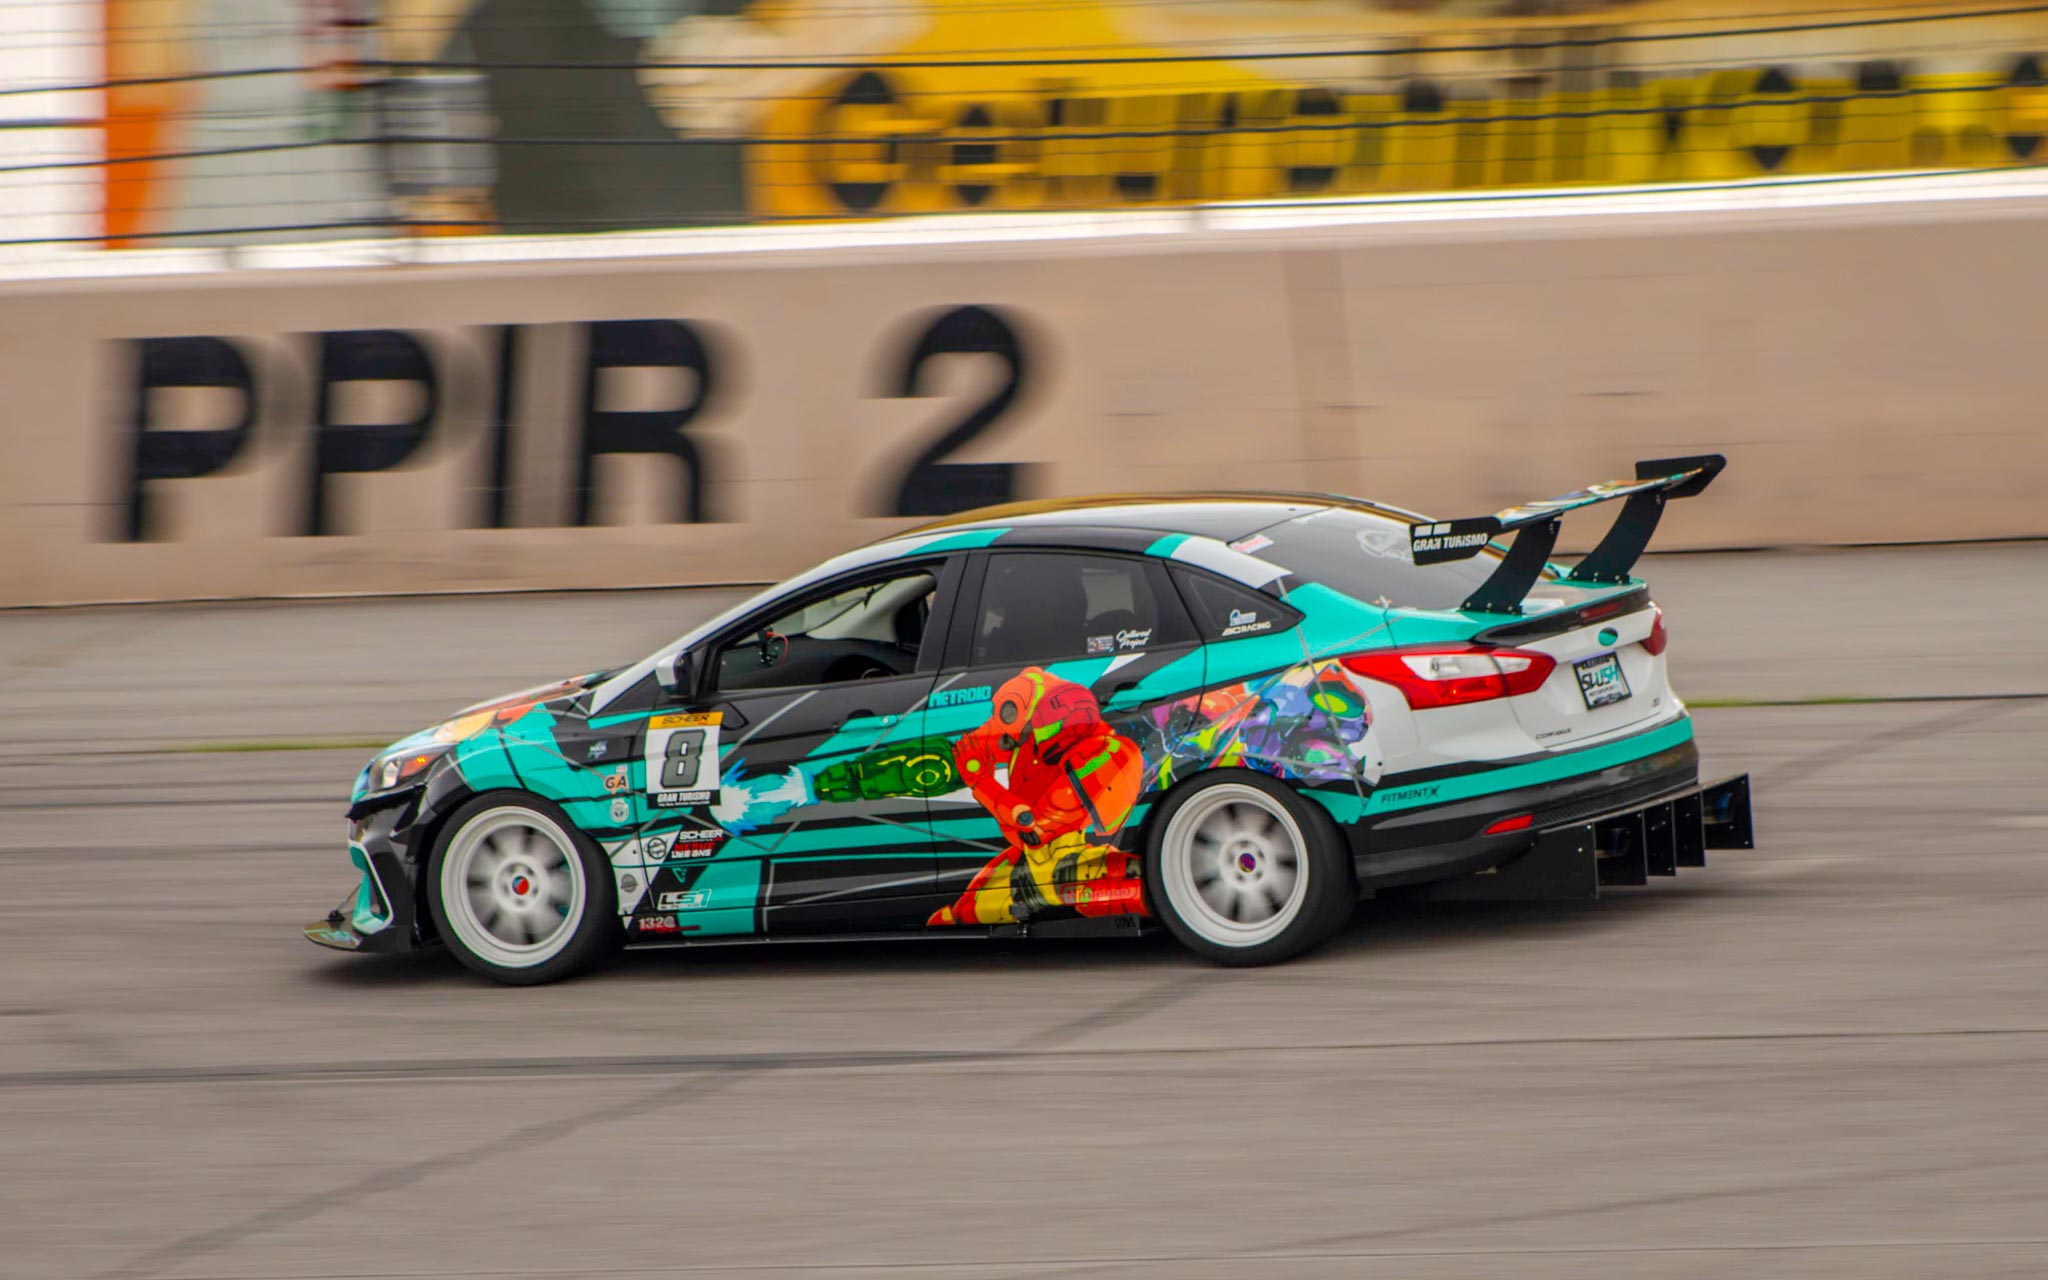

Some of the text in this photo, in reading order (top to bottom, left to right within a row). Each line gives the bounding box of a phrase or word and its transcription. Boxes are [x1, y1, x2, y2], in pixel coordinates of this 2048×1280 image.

[108, 303, 1050, 543] PPIR 2
[1413, 532, 1489, 553] GRAN TURISMO
[1581, 664, 1620, 691] SLUSH
[928, 685, 993, 708] METROID
[659, 728, 707, 789] 8
[657, 792, 678, 804] GRAN
[679, 790, 711, 802] TURISMO
[680, 829, 724, 841] SCHEER
